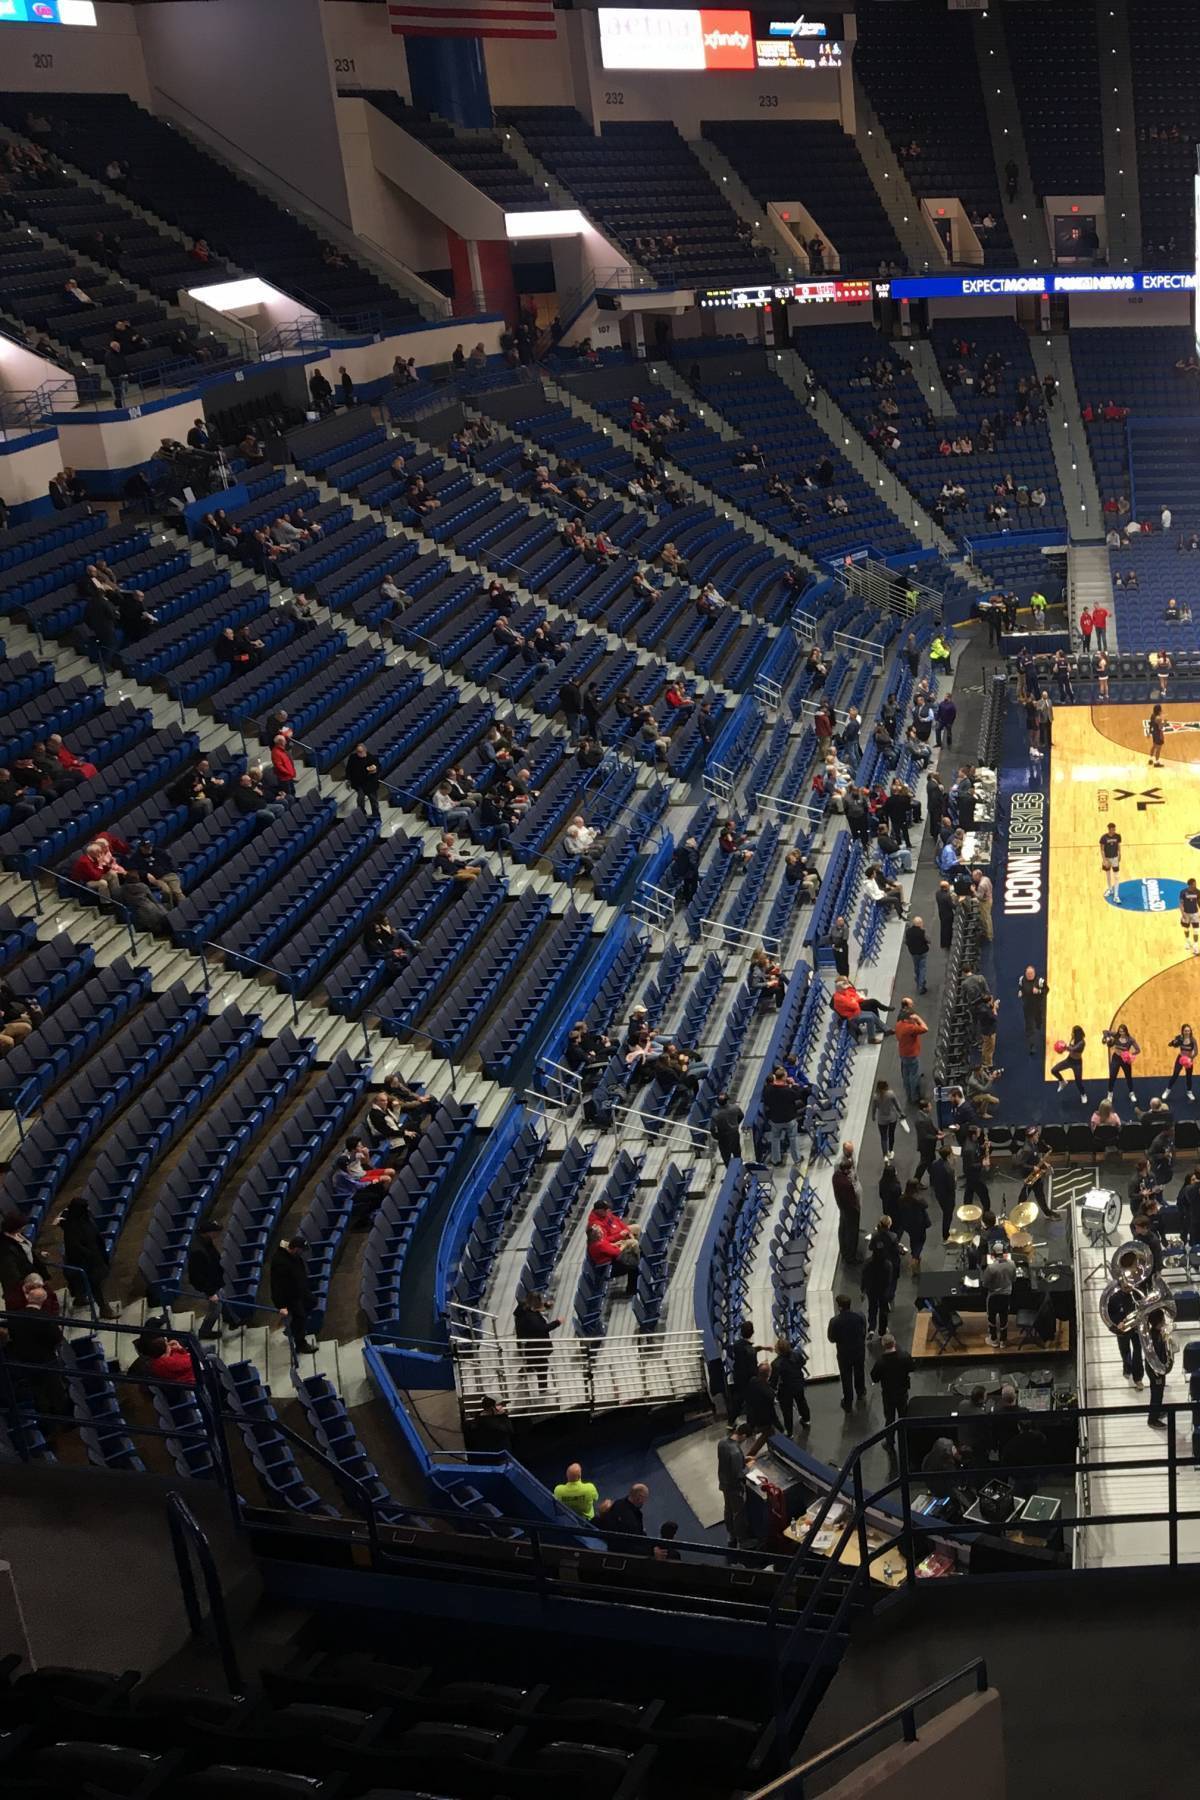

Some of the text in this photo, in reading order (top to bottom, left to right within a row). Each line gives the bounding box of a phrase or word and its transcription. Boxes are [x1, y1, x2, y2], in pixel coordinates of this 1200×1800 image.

[704, 31, 749, 50] xfinity
[33, 54, 54, 68] 207
[334, 58, 355, 72] 231
[605, 92, 624, 105] 232
[759, 96, 778, 107] 233
